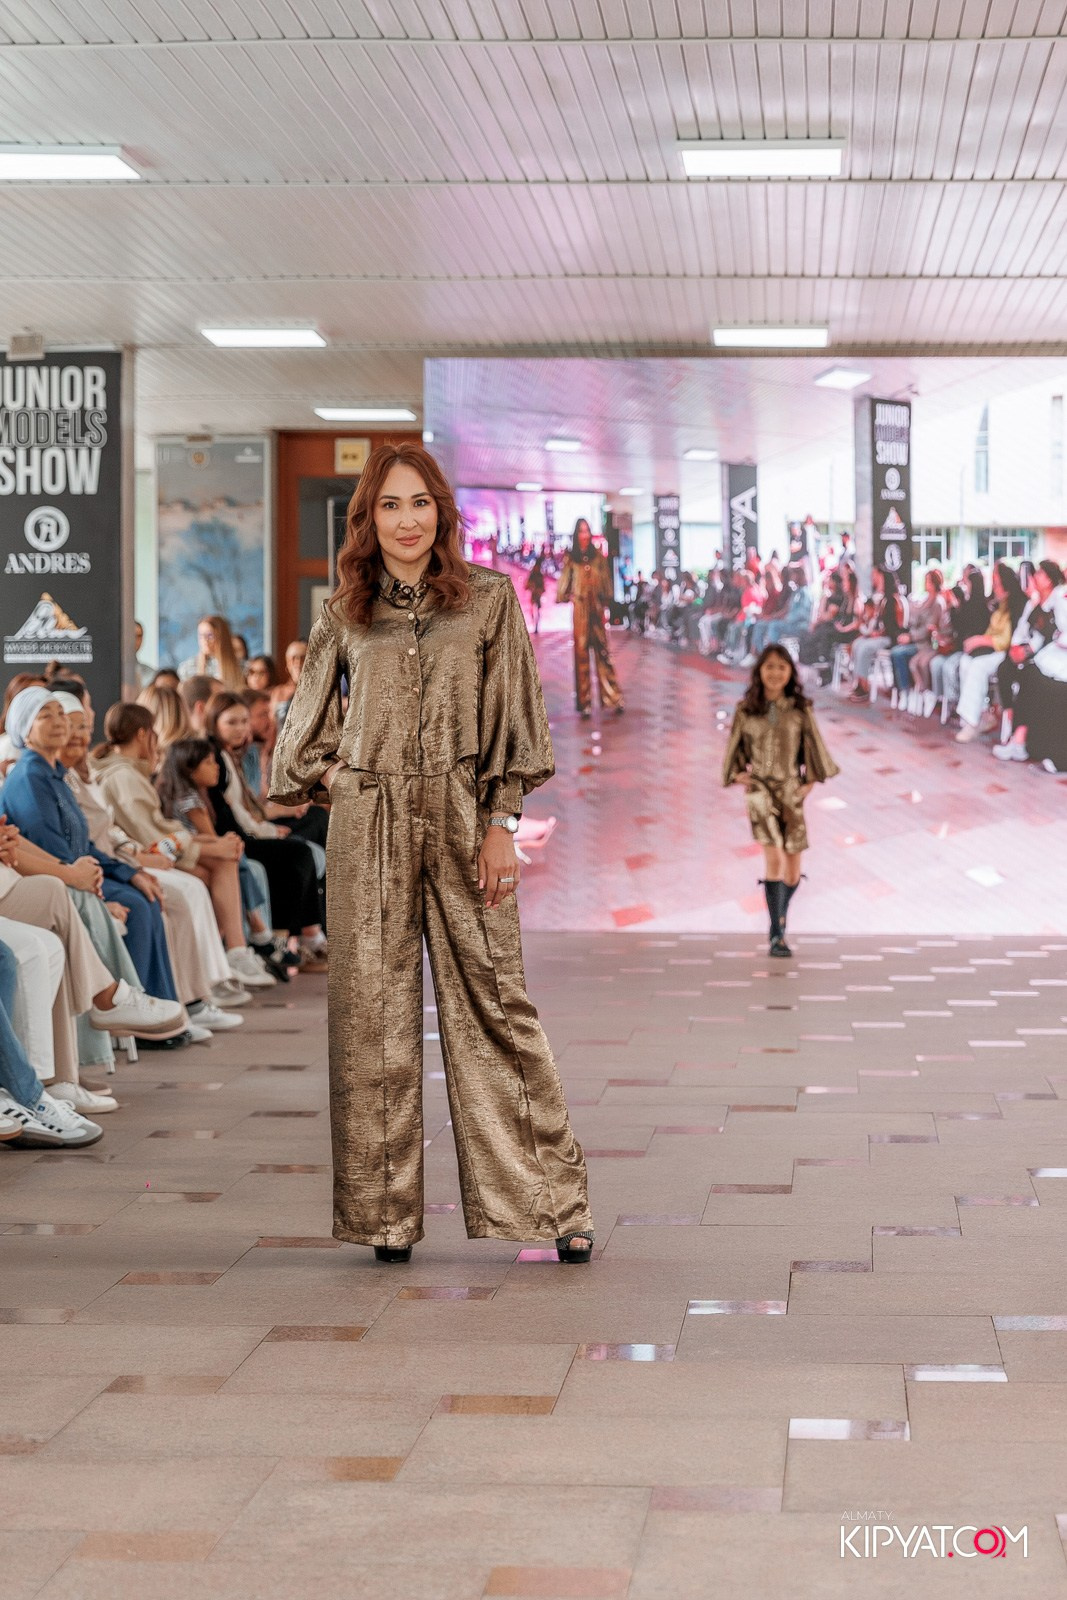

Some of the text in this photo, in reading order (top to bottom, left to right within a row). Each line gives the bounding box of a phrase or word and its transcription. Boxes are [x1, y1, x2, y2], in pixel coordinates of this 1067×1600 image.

[0, 366, 107, 410] UNIOR
[876, 440, 909, 466] SHOW
[0, 447, 102, 496] SHOW
[4, 552, 91, 574] ANDRES
